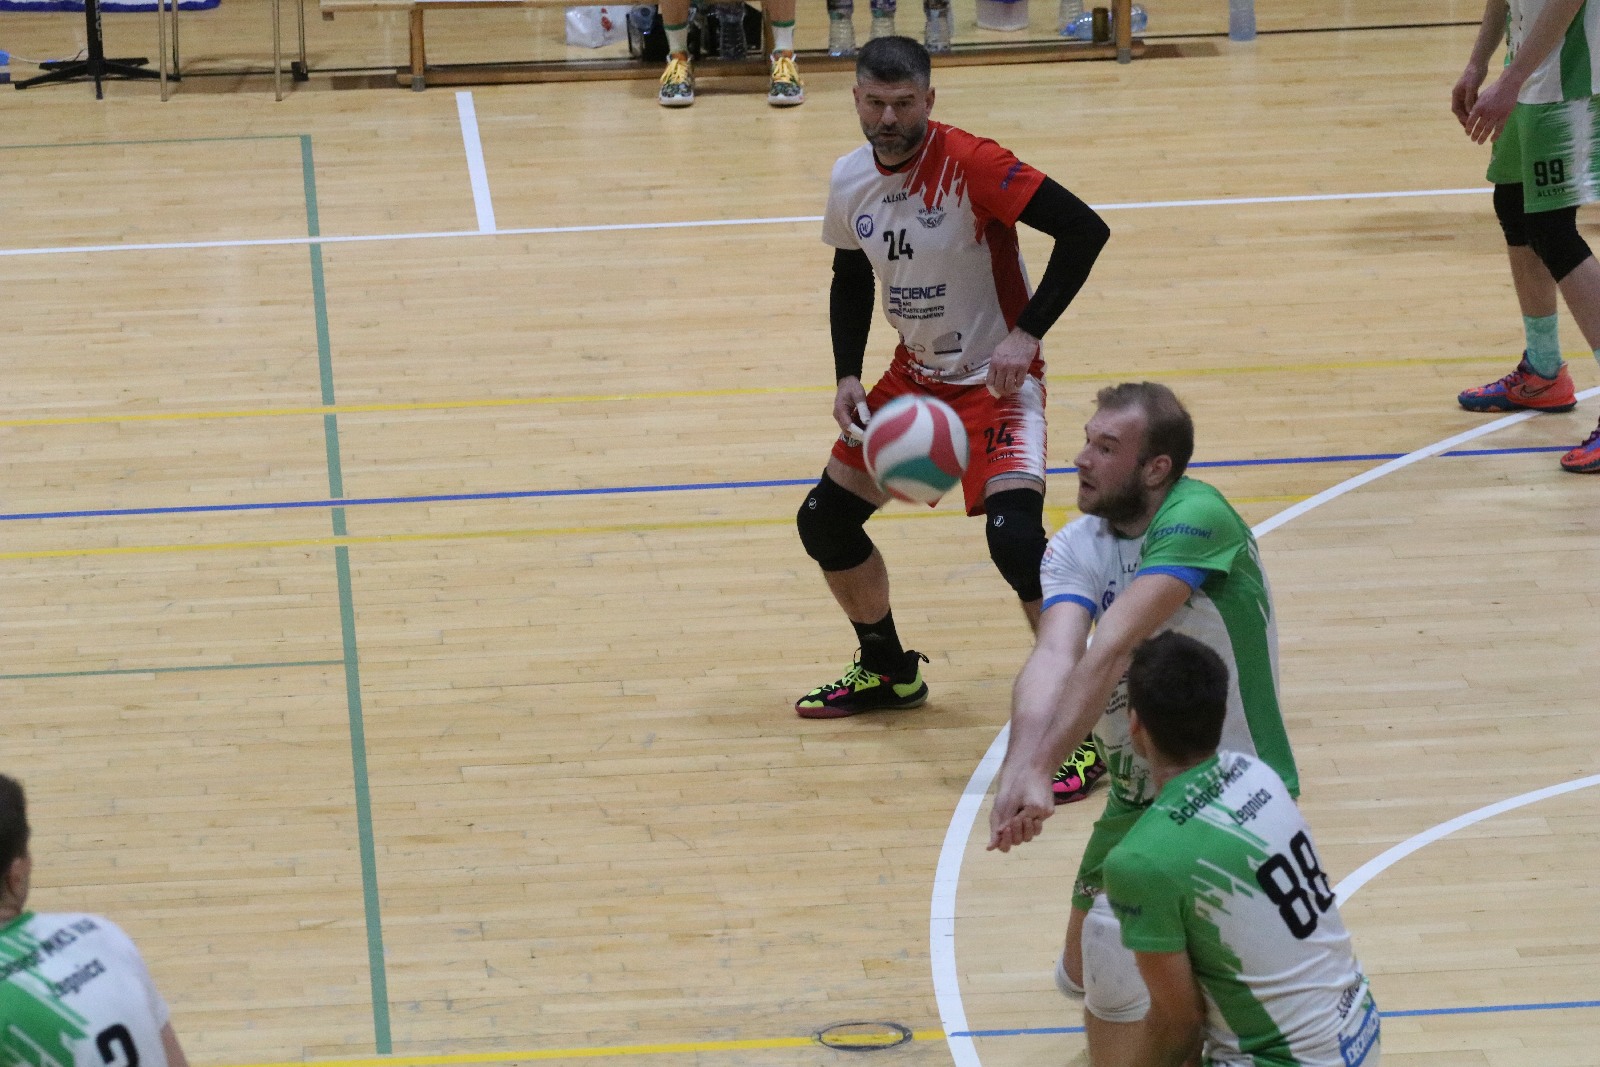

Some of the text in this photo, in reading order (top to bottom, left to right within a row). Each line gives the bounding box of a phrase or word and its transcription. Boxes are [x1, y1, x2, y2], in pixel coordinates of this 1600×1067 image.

[1534, 158, 1565, 187] 99
[882, 192, 908, 204] ALLSIX
[1537, 187, 1567, 198] ALLSIX
[883, 229, 914, 262] 24
[984, 421, 1015, 455] 24
[1168, 780, 1225, 826] Science
[1227, 787, 1273, 826] Legnica
[1256, 829, 1337, 940] 88
